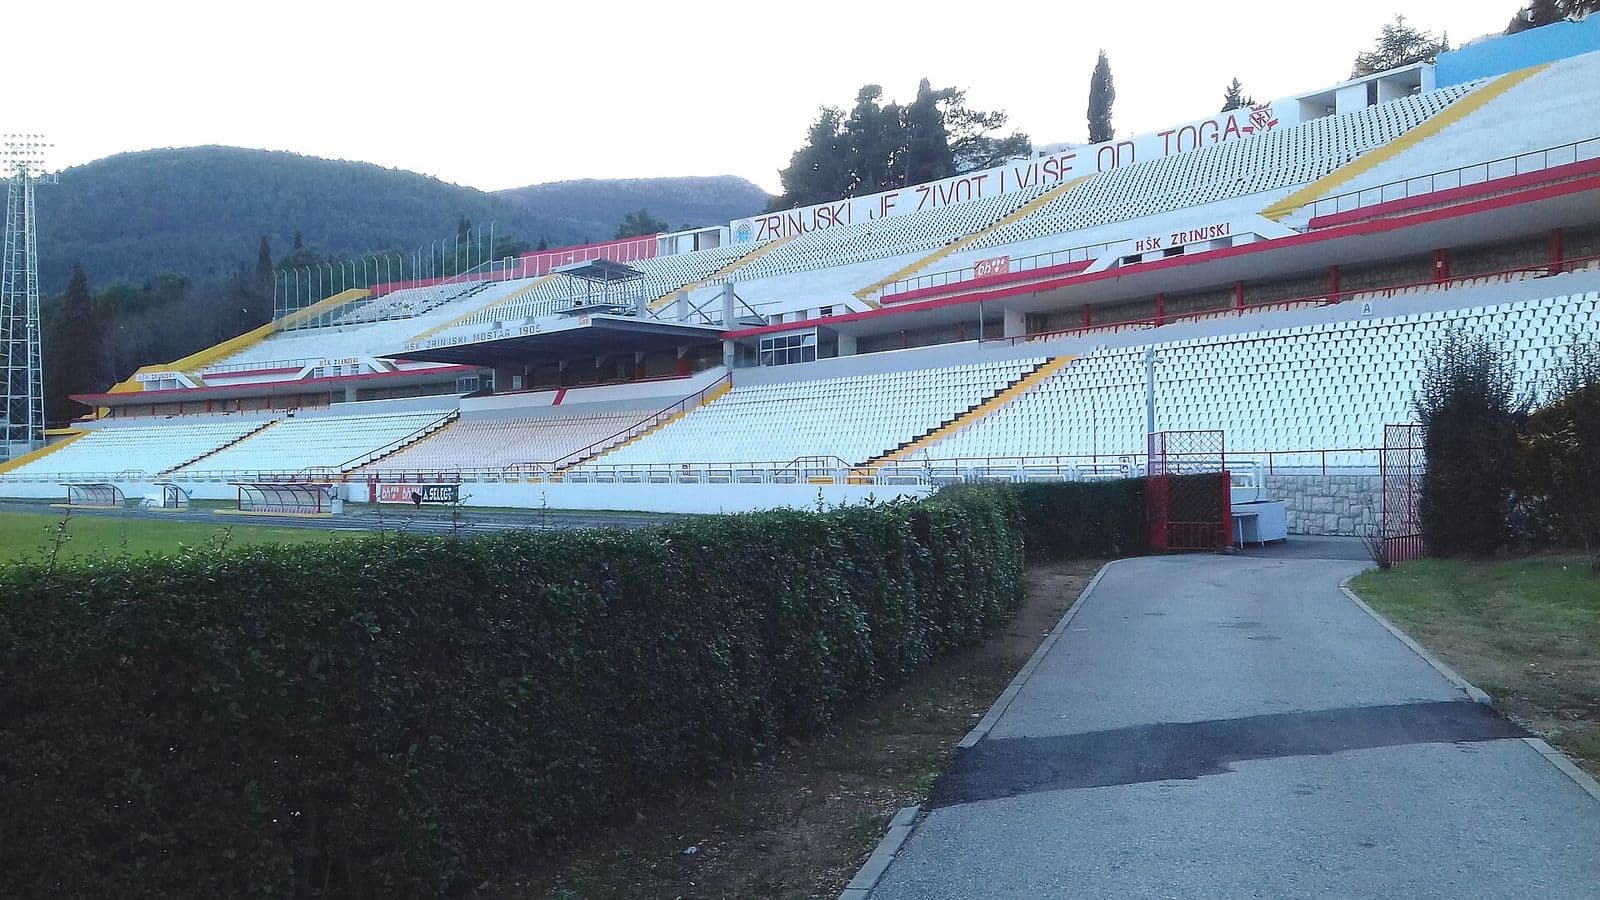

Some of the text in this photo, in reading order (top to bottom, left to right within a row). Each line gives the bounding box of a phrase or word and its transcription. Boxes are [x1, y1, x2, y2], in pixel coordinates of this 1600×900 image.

[755, 202, 851, 242] ZRINJSKI
[869, 193, 898, 221] JE
[916, 174, 988, 211] ŽIVOT
[1001, 170, 1004, 195] I
[1097, 140, 1135, 172] OD
[1157, 115, 1241, 156] TOGA
[1136, 222, 1230, 251] HŠK ZRINJSKI
[1363, 303, 1371, 314] A
[519, 324, 541, 335] 1905
[429, 487, 453, 501] SELECT
